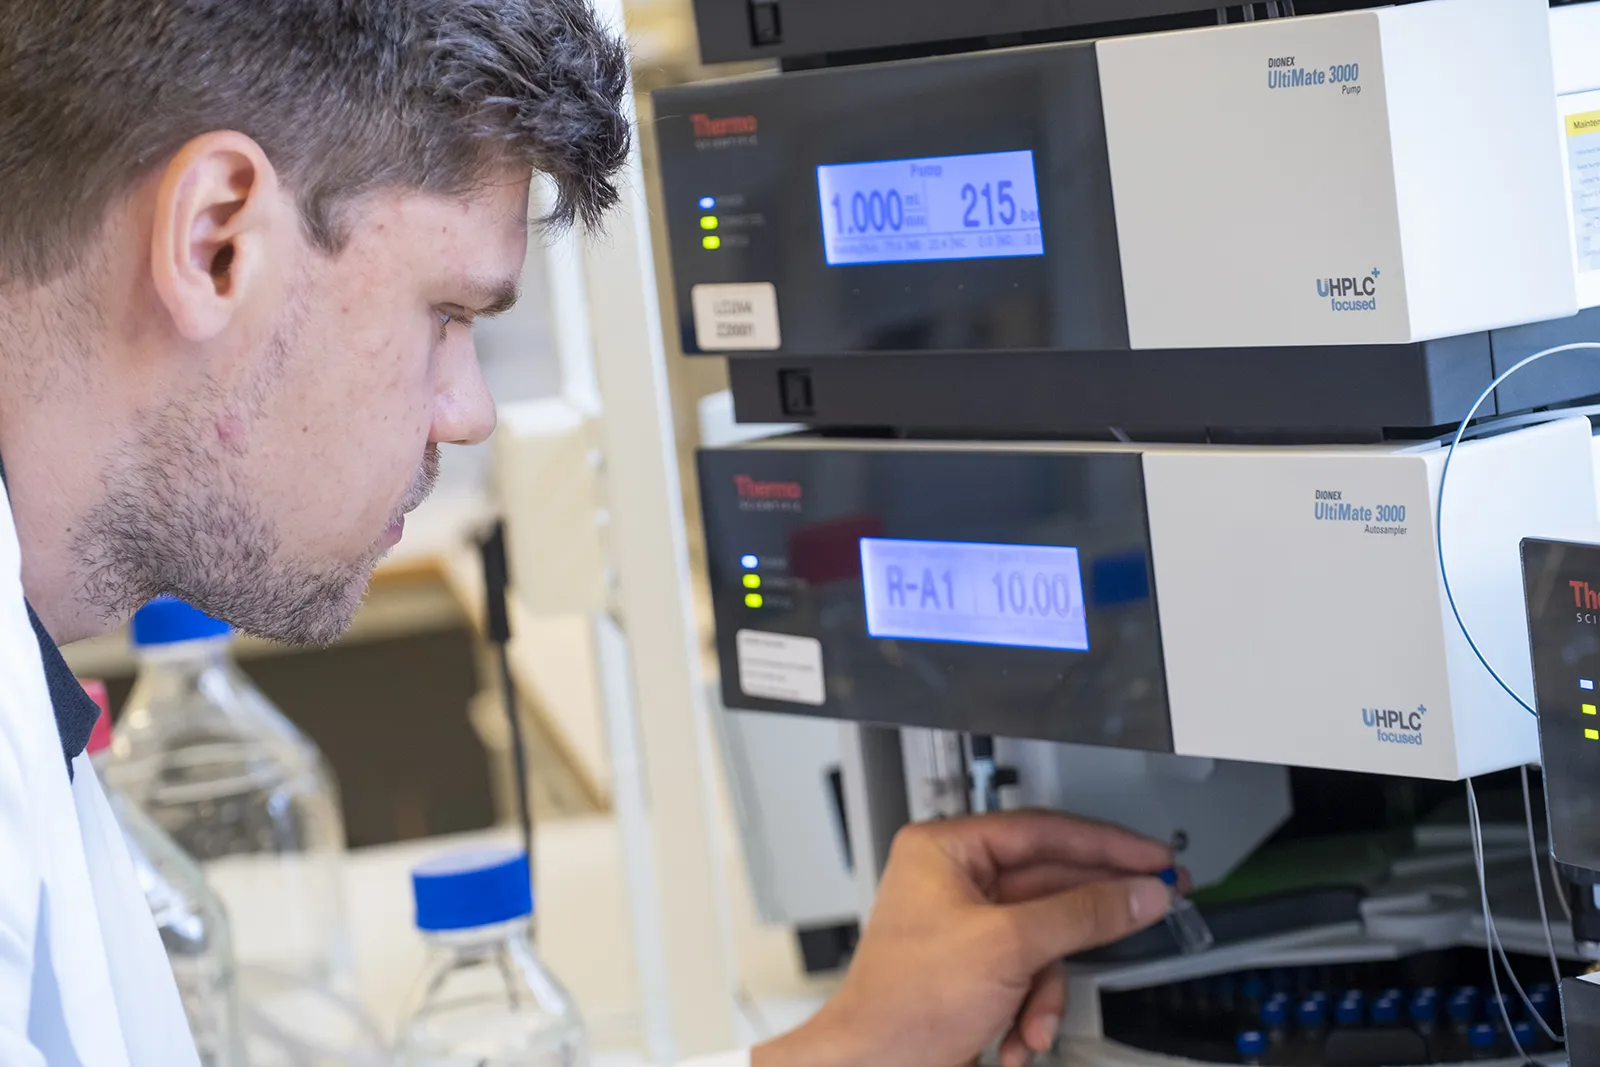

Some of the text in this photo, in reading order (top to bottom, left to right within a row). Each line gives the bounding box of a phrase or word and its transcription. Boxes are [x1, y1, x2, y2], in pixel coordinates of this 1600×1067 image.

[1268, 56, 1296, 68] DIONEX
[1267, 62, 1360, 89] UltiMate 3000
[1341, 84, 1362, 96] Pump
[910, 163, 943, 179] Pump
[830, 179, 1017, 234] 1.000 215
[1331, 297, 1377, 312] focused
[1315, 488, 1342, 501] DIONEX
[1314, 501, 1407, 523] UltiMate 3000
[1364, 524, 1408, 537] Autosampler
[885, 564, 1071, 618] R-A1 10.00
[1569, 580, 1600, 610] Th
[1377, 728, 1423, 746] focused
